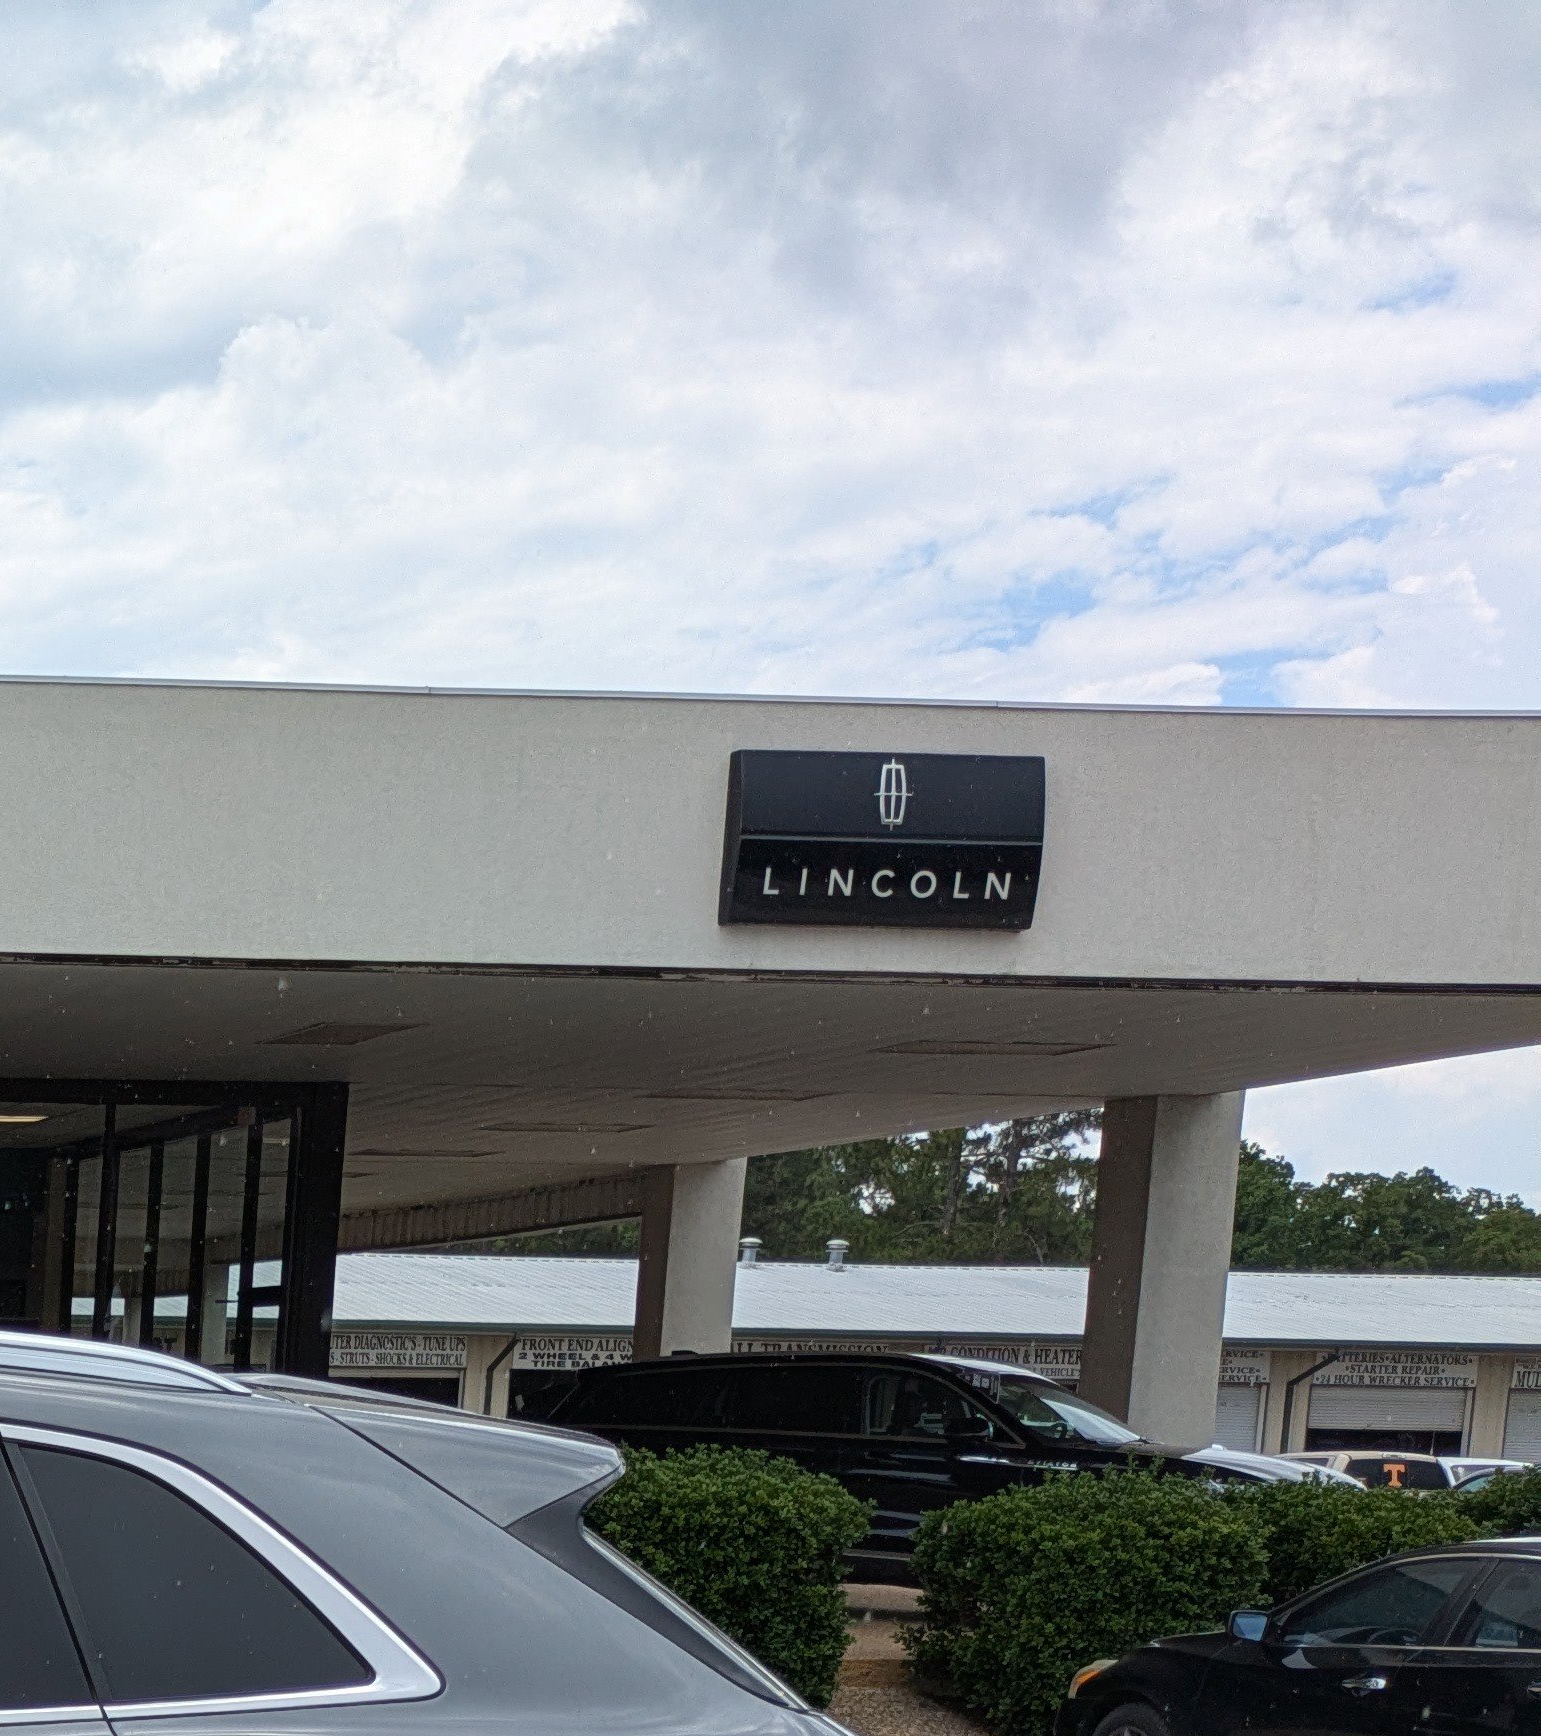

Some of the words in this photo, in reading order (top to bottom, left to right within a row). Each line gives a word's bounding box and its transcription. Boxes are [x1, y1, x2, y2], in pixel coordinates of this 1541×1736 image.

[763, 867, 1012, 900] LINCOLN
[422, 1336, 446, 1352] TUNE
[450, 1337, 466, 1352] UPS
[567, 1339, 594, 1352] END
[340, 1352, 370, 1365] STRUTS
[375, 1352, 406, 1366] SHOCKS
[415, 1353, 464, 1366] ELECTRICAL
[518, 1352, 528, 1360] 2
[532, 1352, 587, 1361] WHEEL
[590, 1353, 600, 1361] &
[531, 1360, 567, 1368] TIRE
[1349, 1364, 1398, 1375] STARTER
[1401, 1365, 1440, 1376] REPAIR
[1334, 1374, 1365, 1385] HOUR
[1368, 1375, 1421, 1386] WRECKER
[1424, 1376, 1469, 1387] SERVICE
